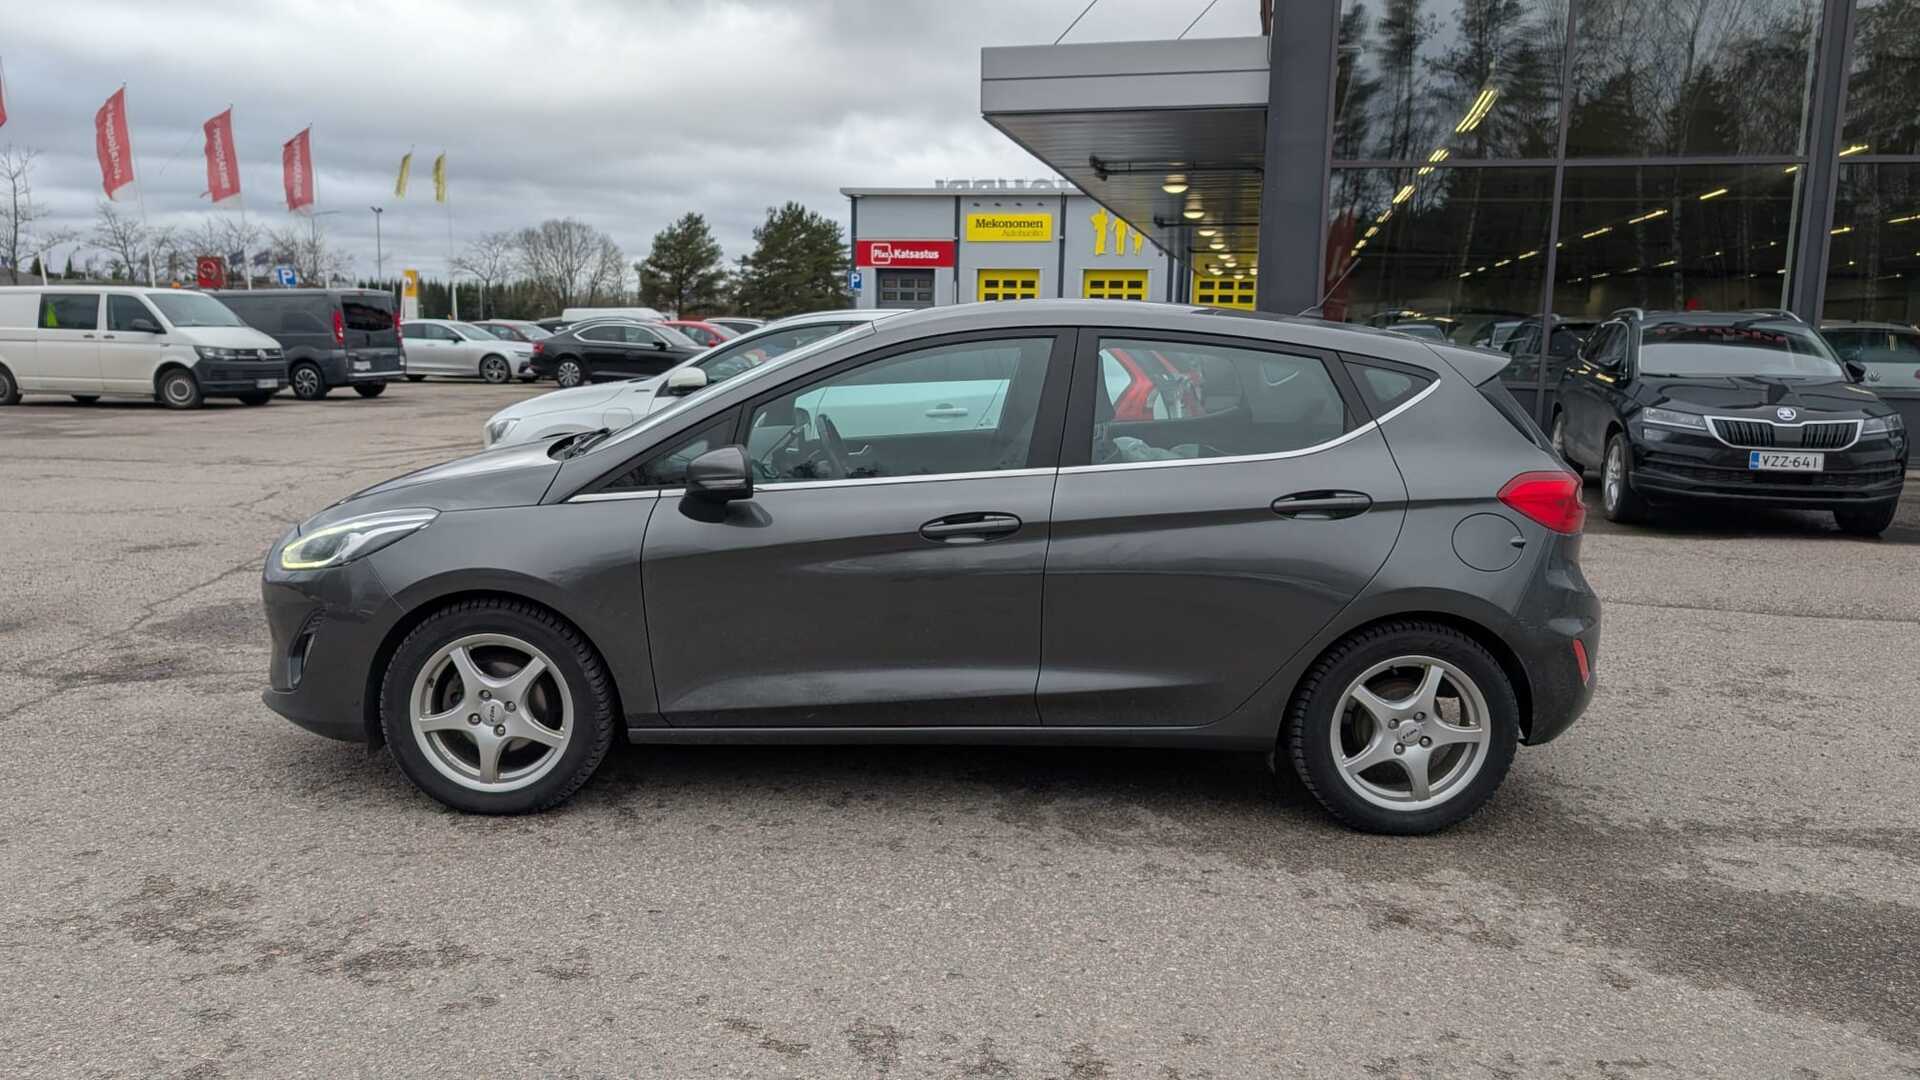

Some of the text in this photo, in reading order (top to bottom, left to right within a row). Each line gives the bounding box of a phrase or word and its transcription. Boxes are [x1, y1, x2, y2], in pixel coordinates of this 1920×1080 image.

[975, 218, 1044, 229] Mekonomen
[894, 248, 940, 259] Katsastus
[281, 268, 293, 284] P
[851, 273, 860, 287] P
[1762, 455, 1817, 468] VZZ-641
